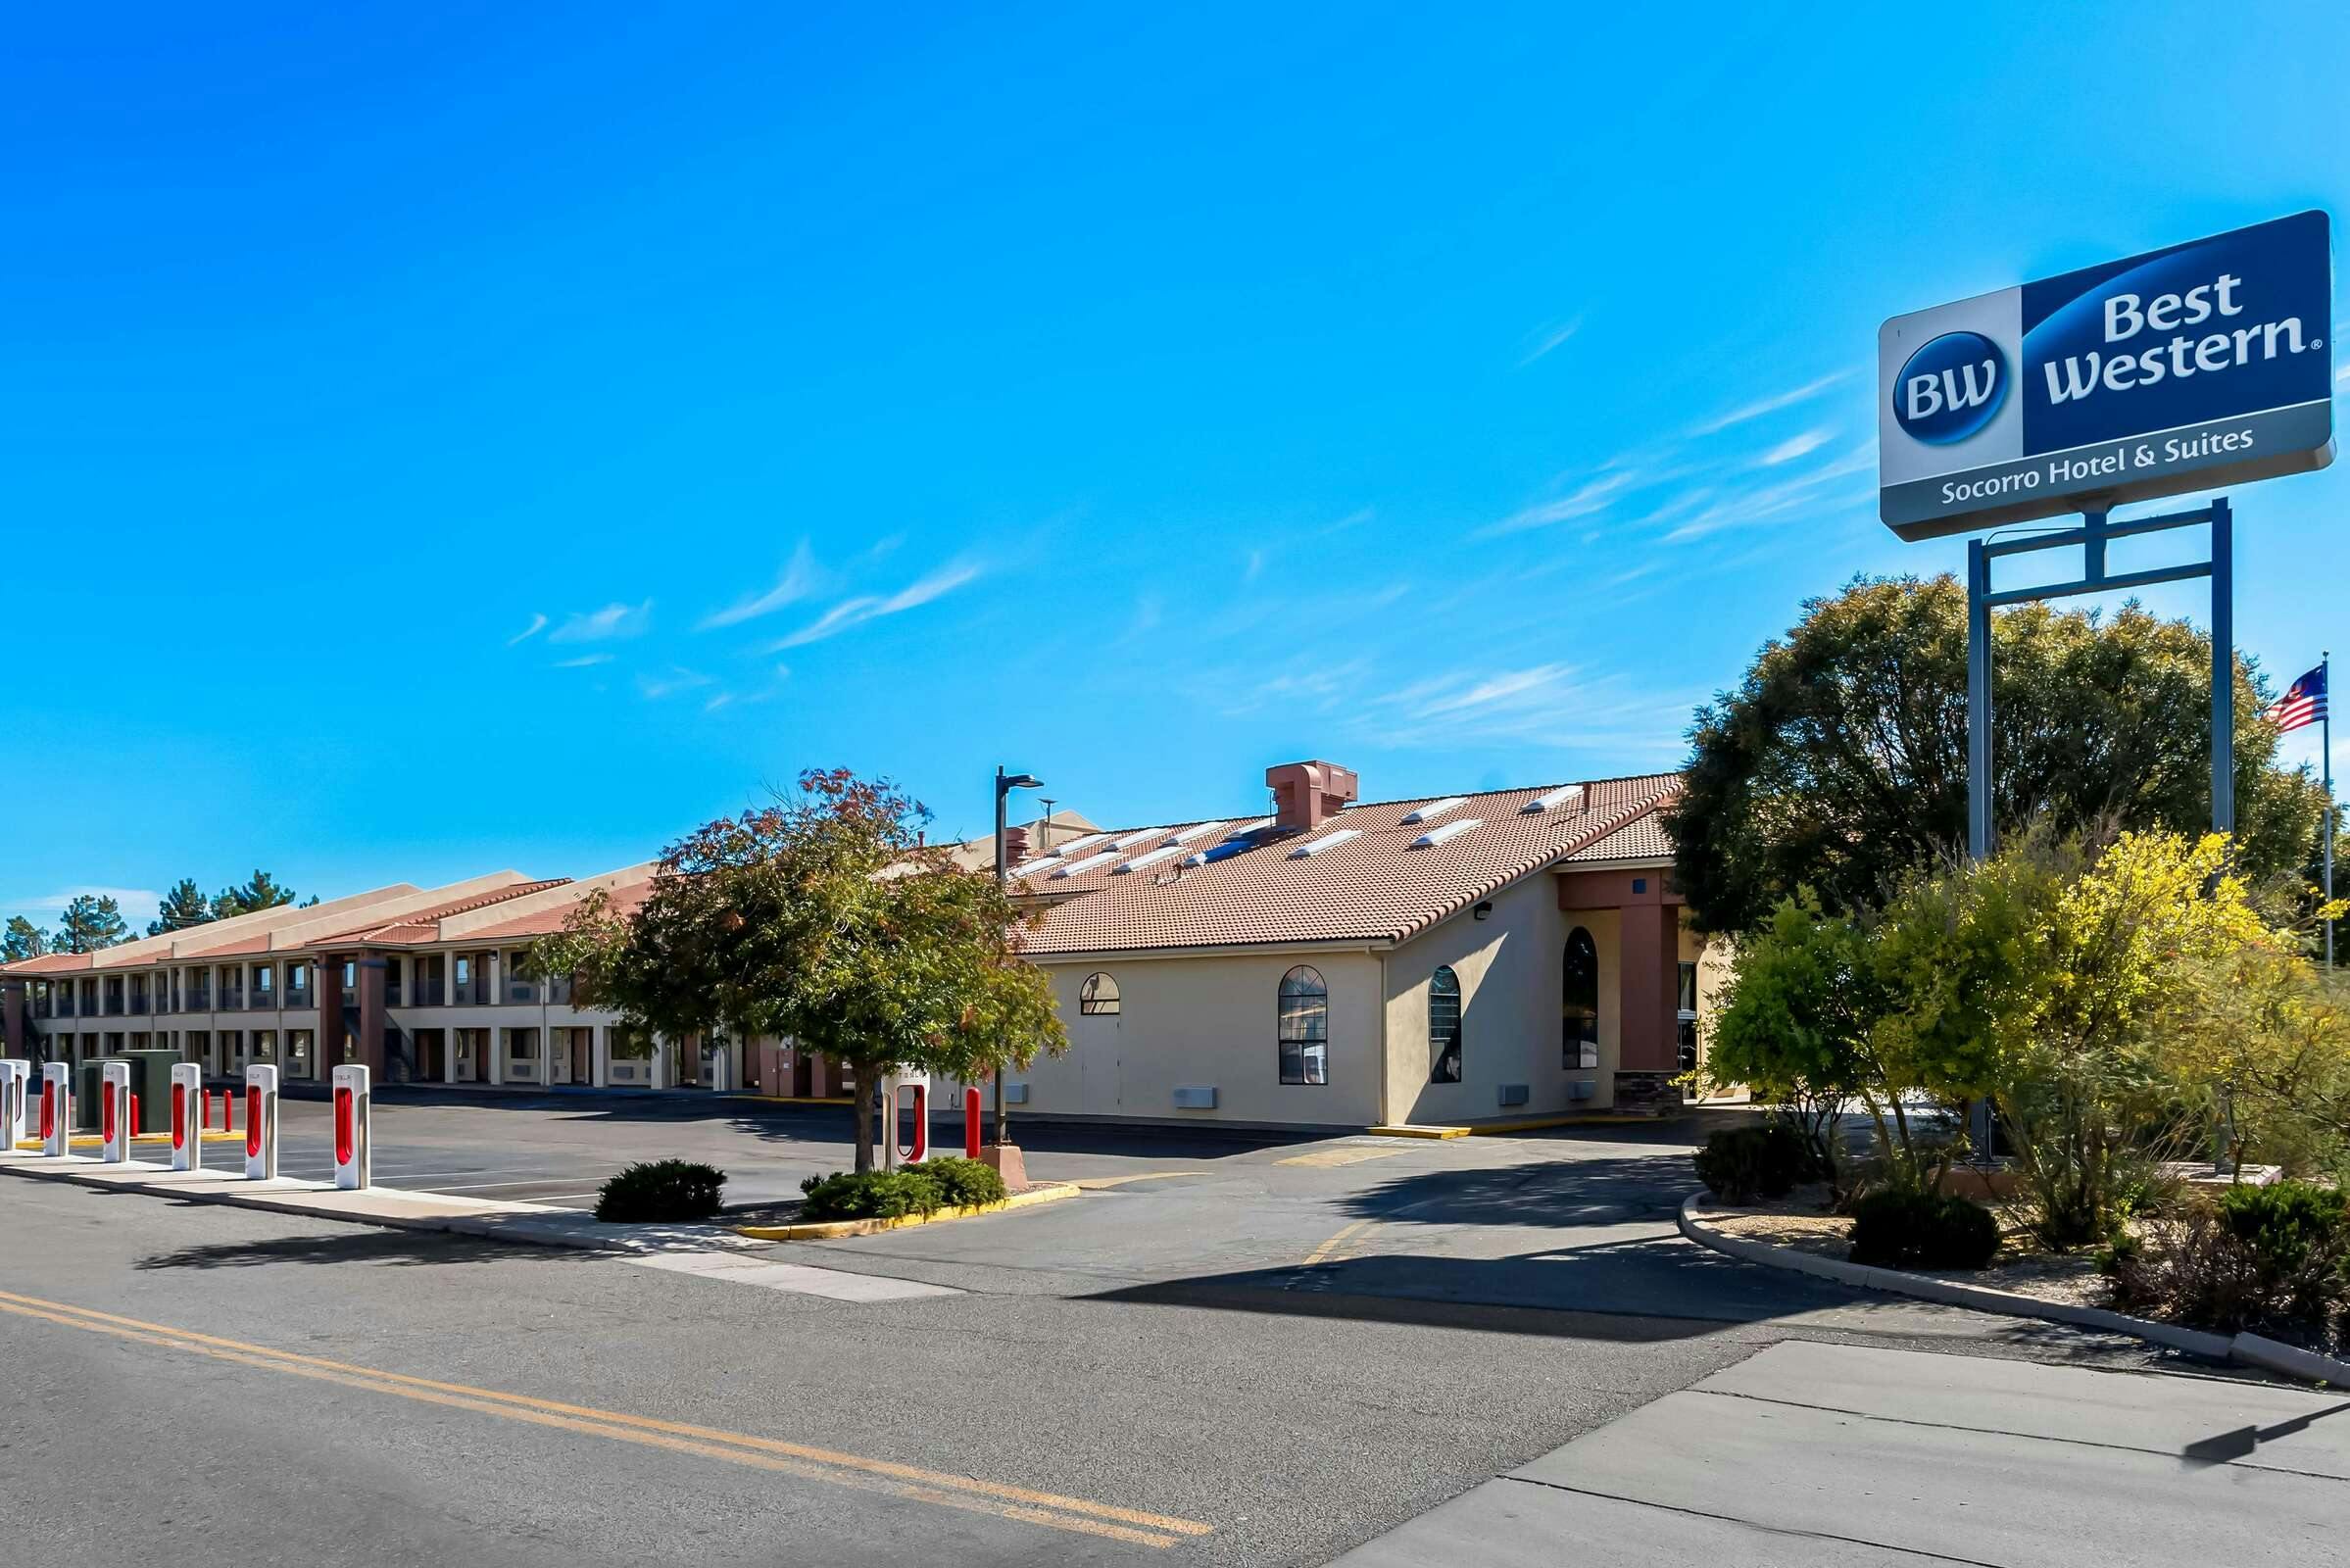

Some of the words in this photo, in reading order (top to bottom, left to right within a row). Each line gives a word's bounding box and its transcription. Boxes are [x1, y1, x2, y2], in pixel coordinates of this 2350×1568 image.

[2104, 273, 2243, 343] Best
[1907, 359, 1996, 420] BW
[1941, 469, 2040, 504] Socorro
[2049, 448, 2126, 484] Hotel
[2133, 444, 2156, 467] &
[2164, 429, 2254, 463] Suites
